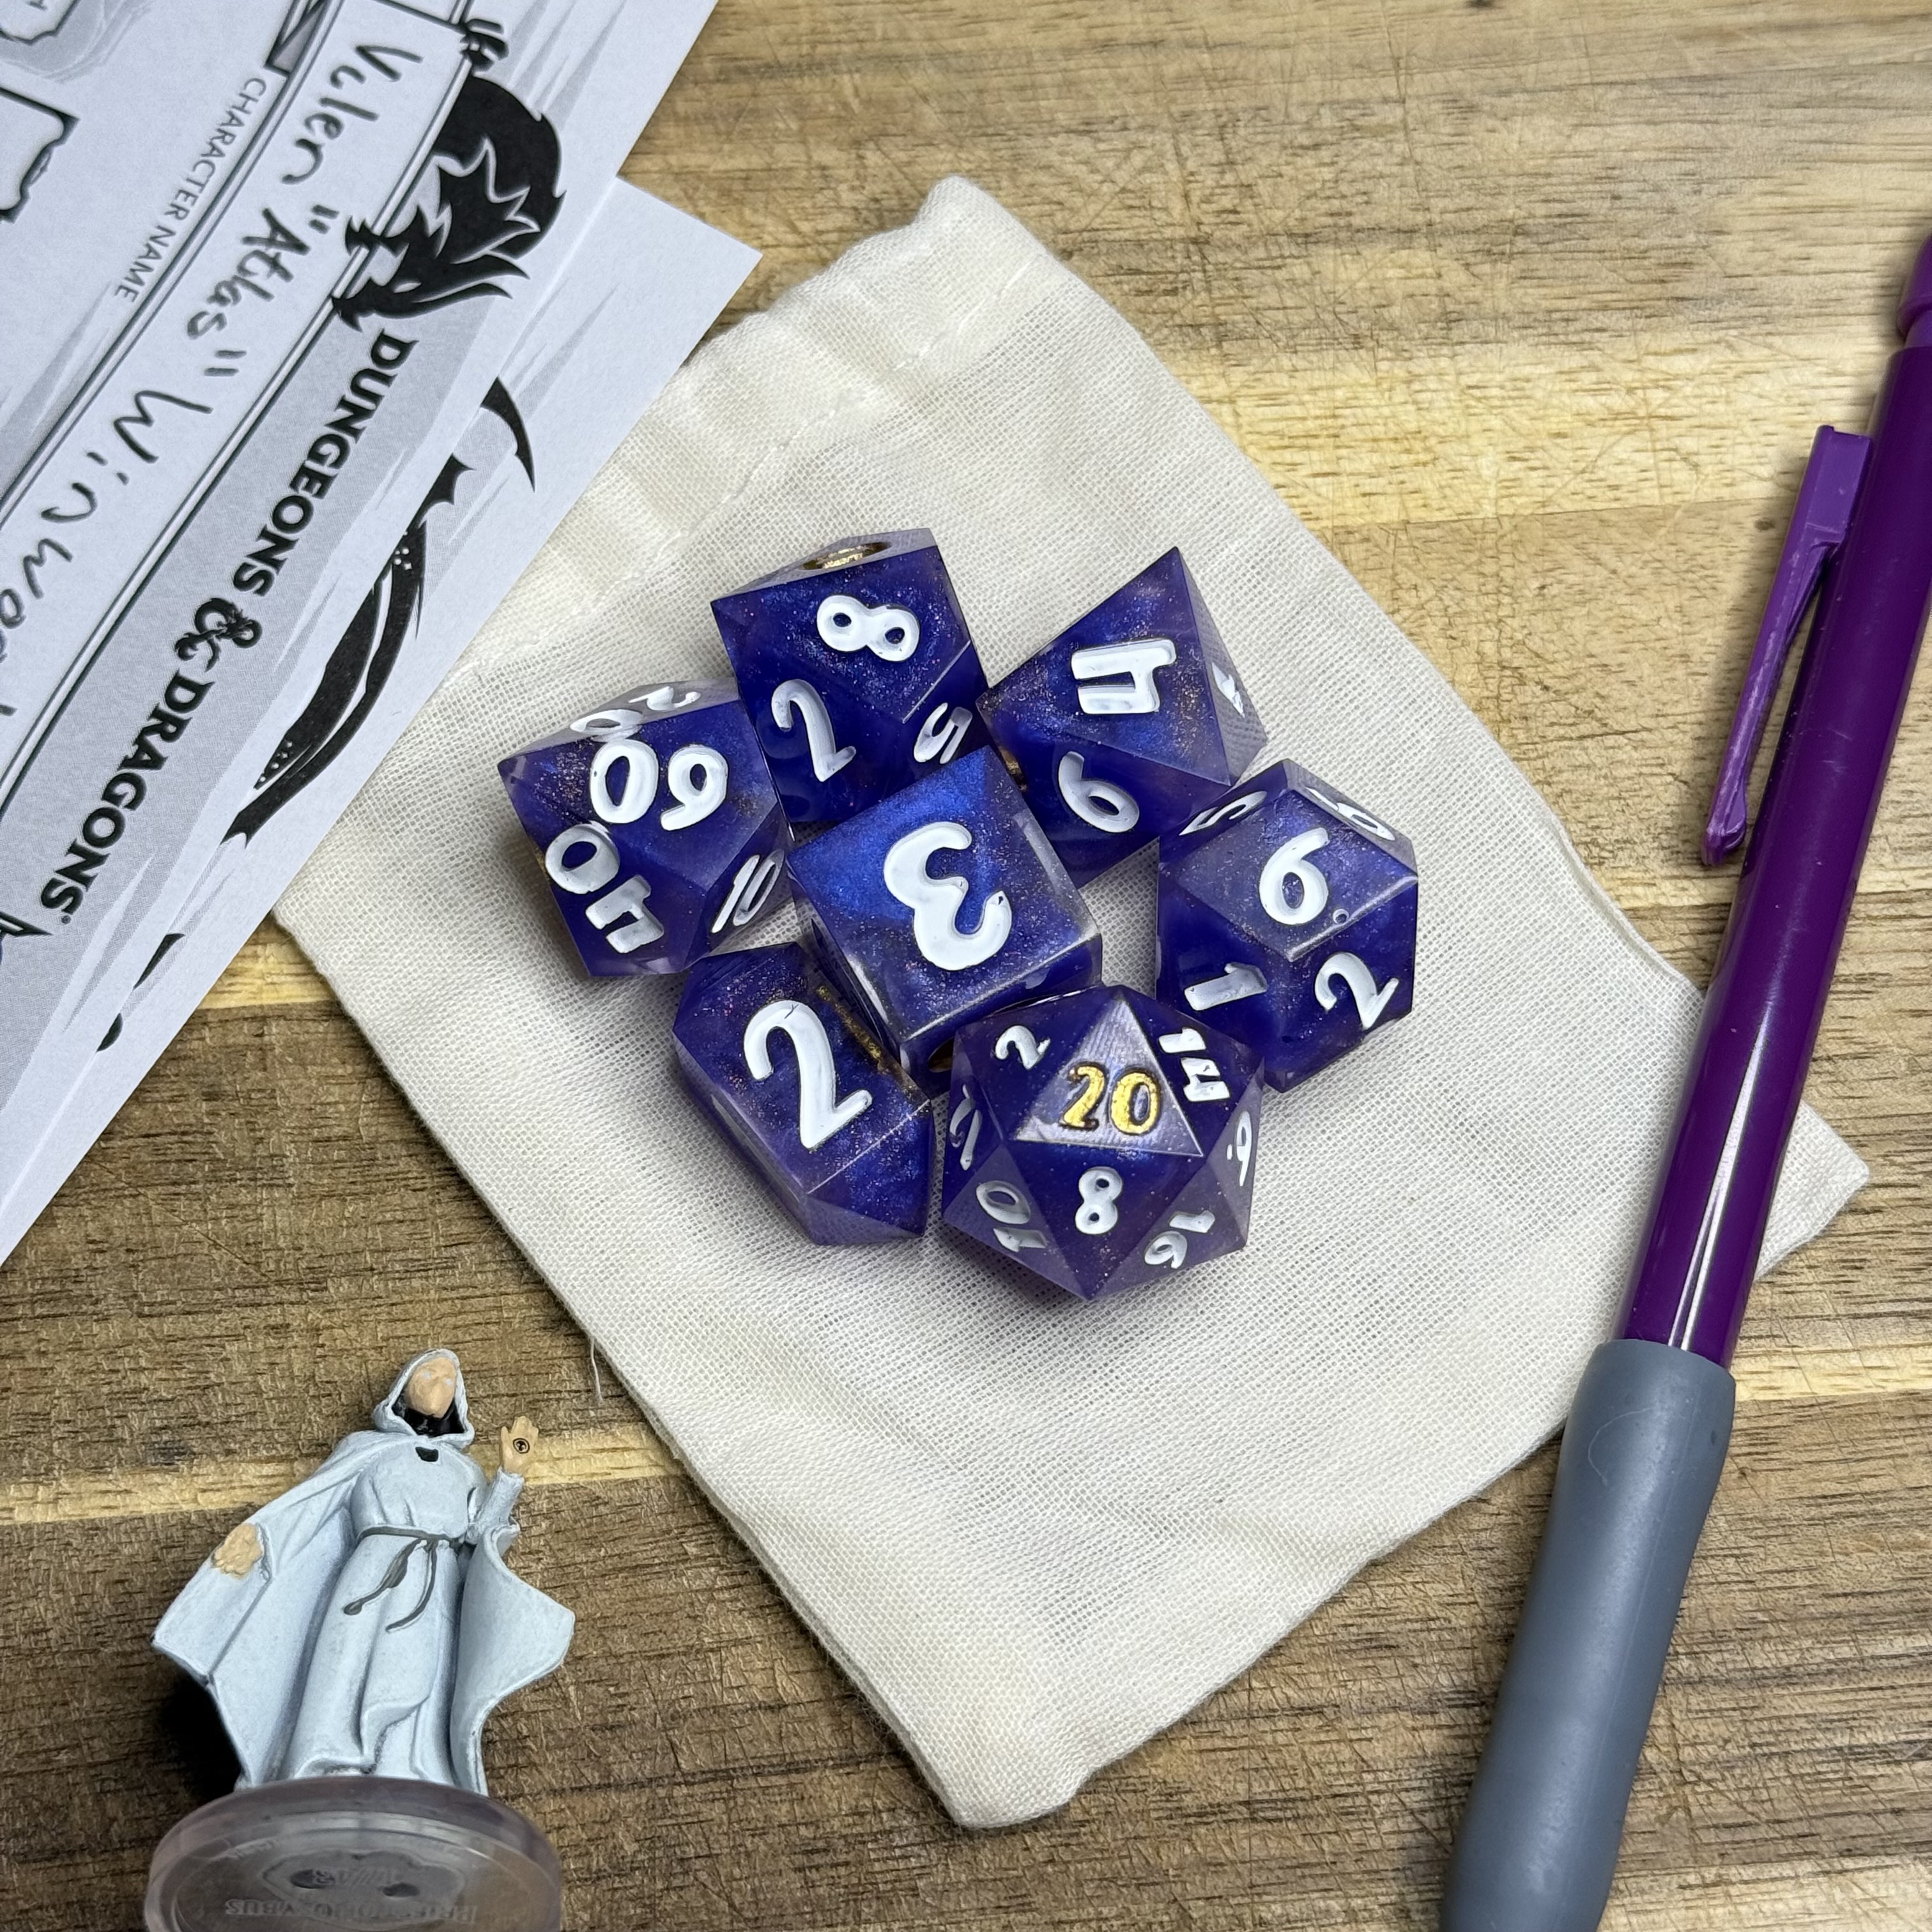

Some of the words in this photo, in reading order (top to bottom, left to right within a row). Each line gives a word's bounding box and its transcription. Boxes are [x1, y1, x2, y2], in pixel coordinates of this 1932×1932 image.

[164, 77, 266, 220] CHARACTER
[116, 225, 177, 303] NAME
[234, 329, 420, 596] DUNGEONS
[0, 390, 213, 717] Winwo
[174, 597, 263, 671] &
[816, 594, 920, 662] 8
[1071, 639, 1177, 714] 4
[771, 678, 856, 782] 2
[1058, 751, 1140, 832] 6
[711, 849, 785, 933] 10
[884, 822, 1012, 970] 3
[1184, 962, 1268, 1011] 1
[1315, 952, 1399, 1030] 2
[744, 1000, 873, 1149] 2
[995, 1025, 1051, 1070] 2
[1159, 1027, 1230, 1102] 14
[1061, 1062, 1162, 1135] 20
[1075, 1167, 1123, 1234] 8
